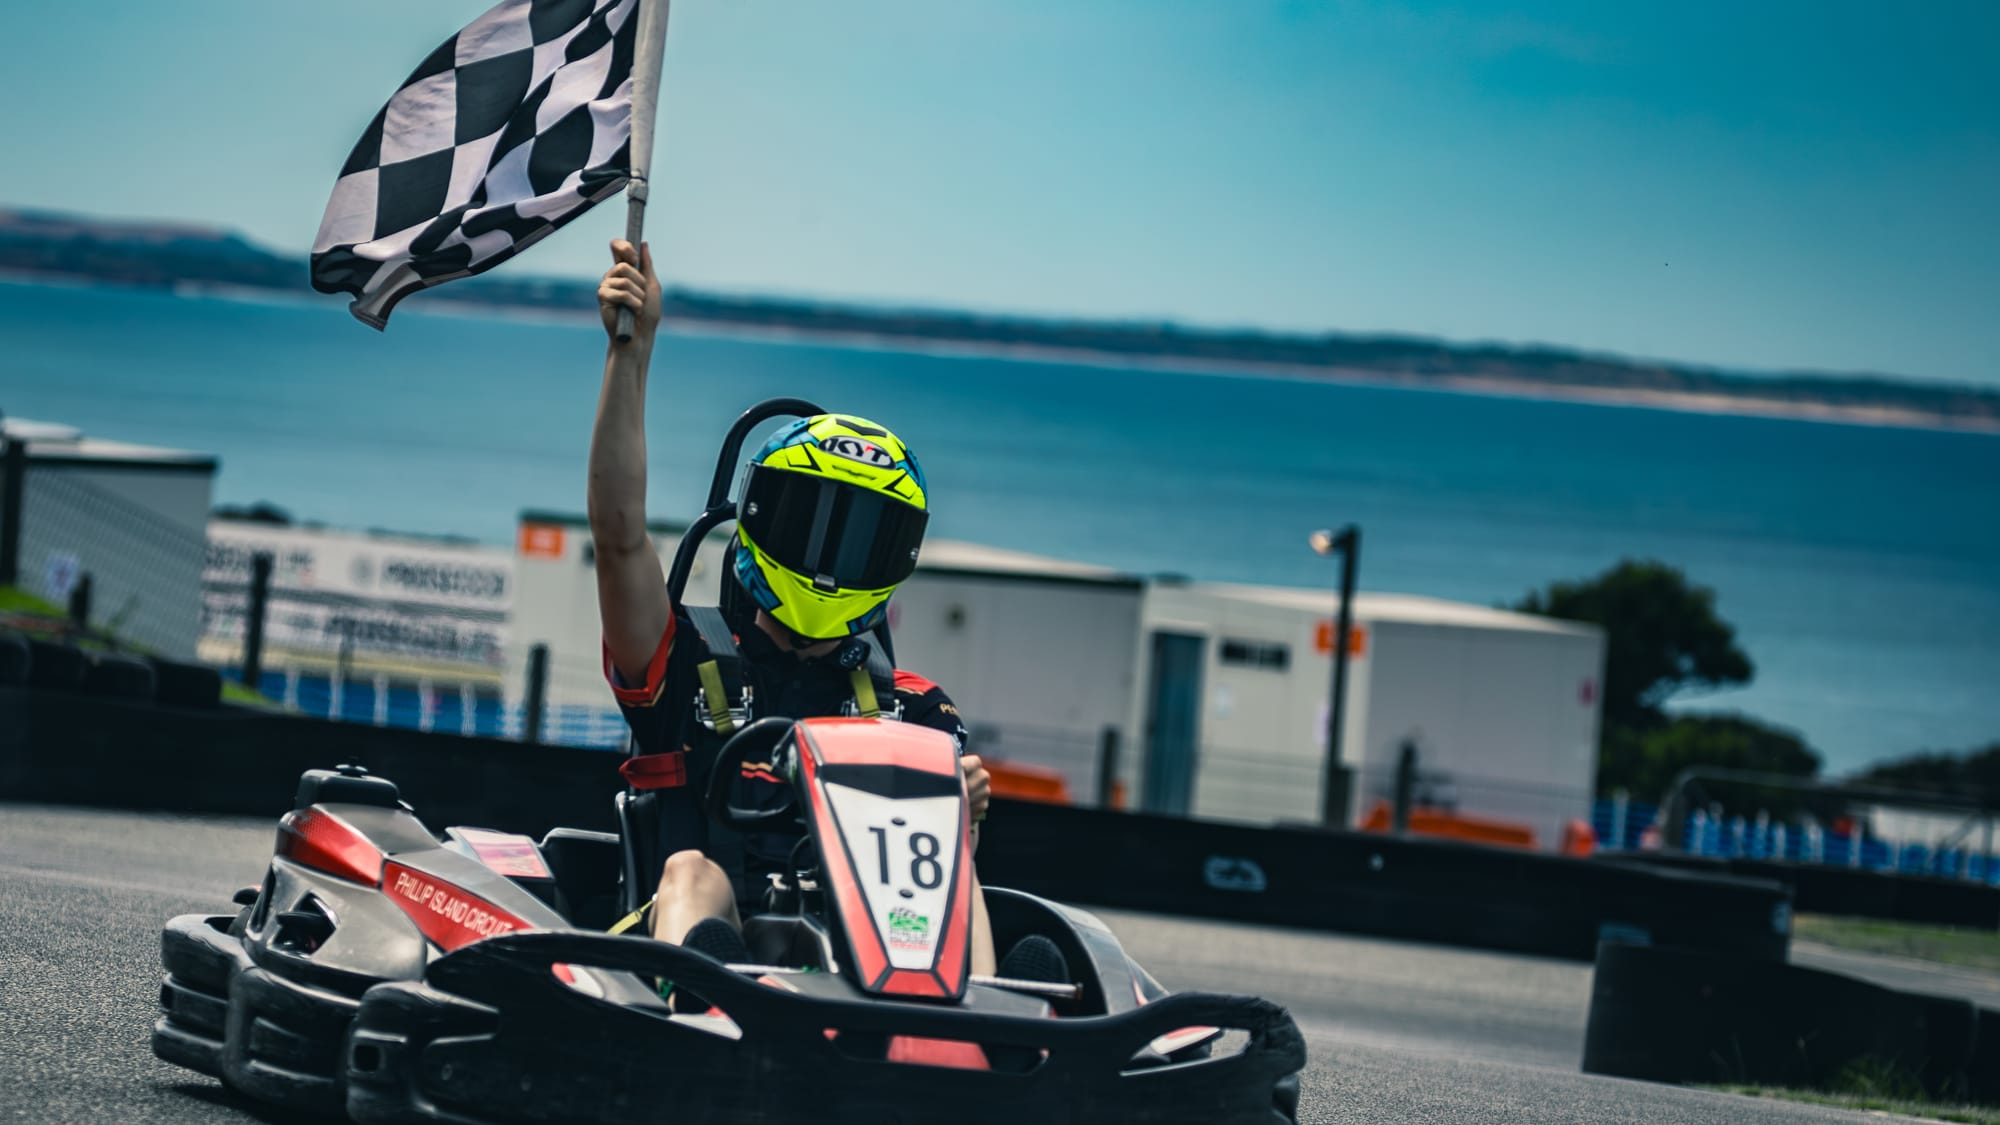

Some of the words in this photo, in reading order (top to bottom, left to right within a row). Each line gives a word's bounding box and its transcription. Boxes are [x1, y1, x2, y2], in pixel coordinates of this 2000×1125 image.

[828, 438, 891, 463] KYT
[868, 826, 943, 890] 18
[394, 872, 434, 904] PHILLIP
[428, 891, 469, 923] ISLAND
